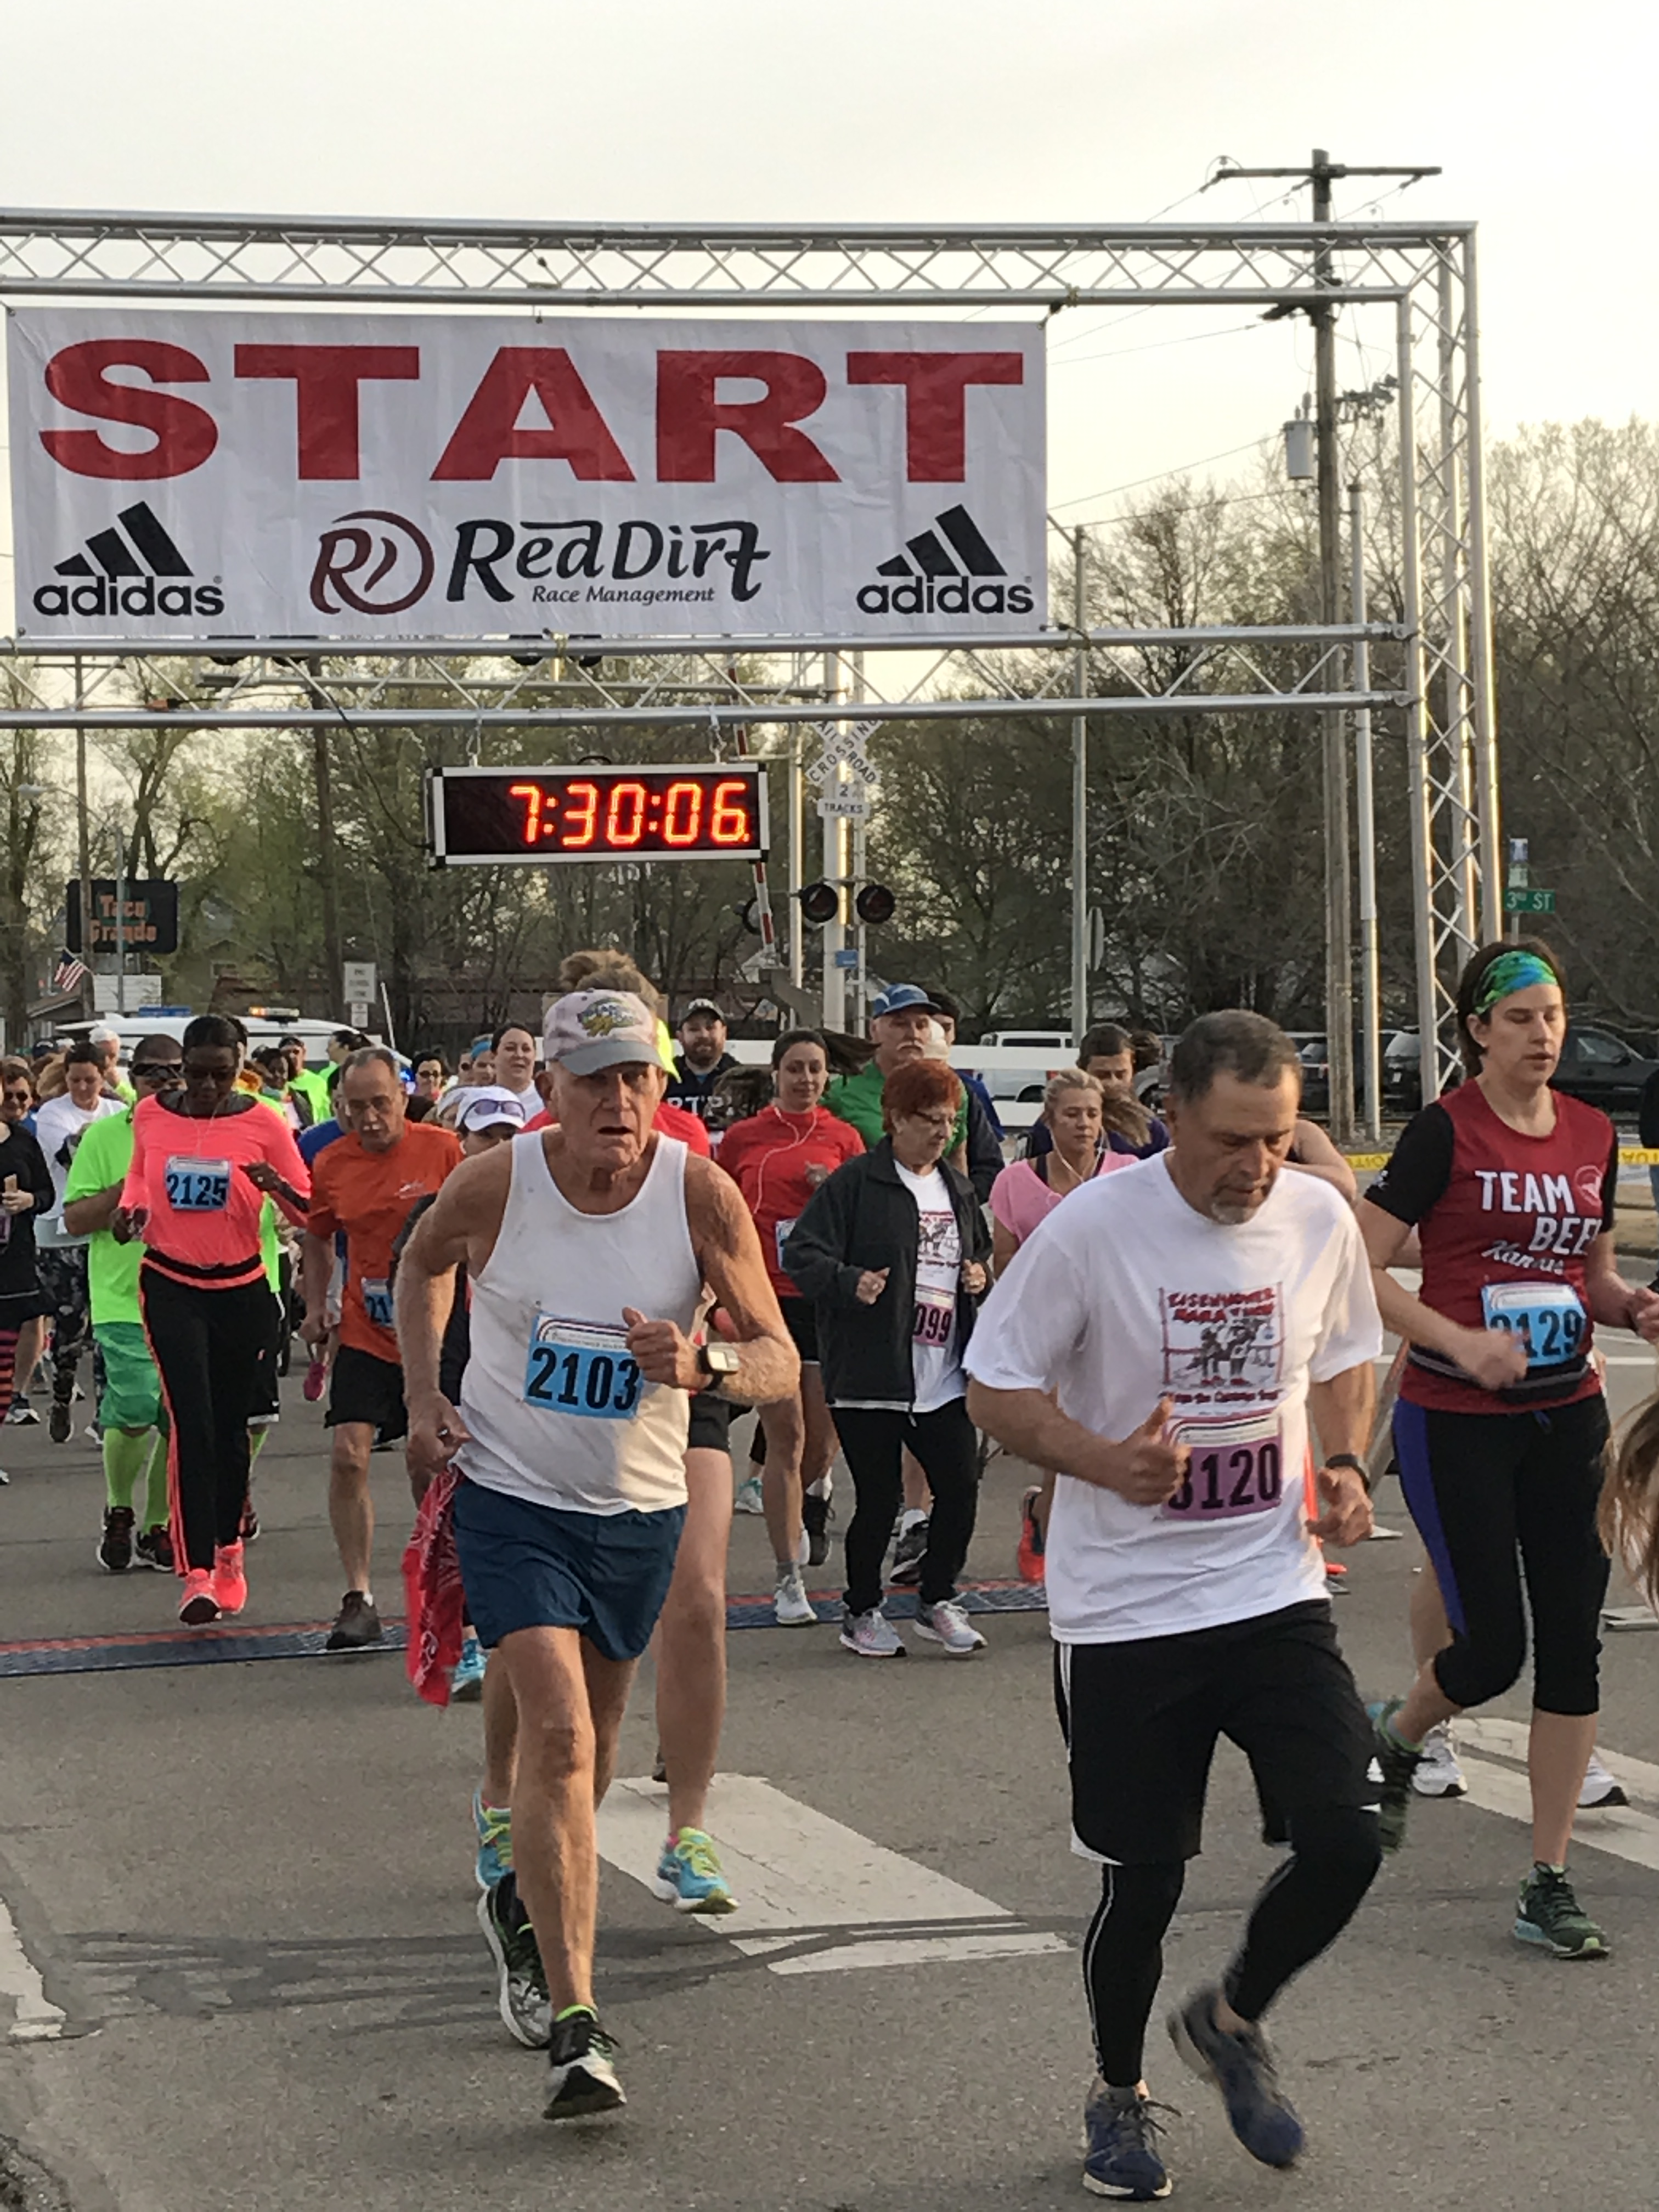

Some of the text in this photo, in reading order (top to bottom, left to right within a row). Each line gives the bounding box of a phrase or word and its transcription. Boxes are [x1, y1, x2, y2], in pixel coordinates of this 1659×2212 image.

[39, 338, 1023, 483] START
[33, 575, 225, 616] adidas
[532, 585, 715, 606] Race Management
[856, 574, 1034, 614] adidas
[847, 751, 877, 783] ROAD
[839, 784, 849, 797] 2
[824, 803, 864, 814] TRACKS
[100, 895, 146, 917] Taco
[1532, 892, 1552, 911] ST
[166, 1173, 229, 1206] 2125
[1475, 1170, 1576, 1214] TEAM
[913, 1304, 953, 1343] 099
[527, 1347, 641, 1411] 2103
